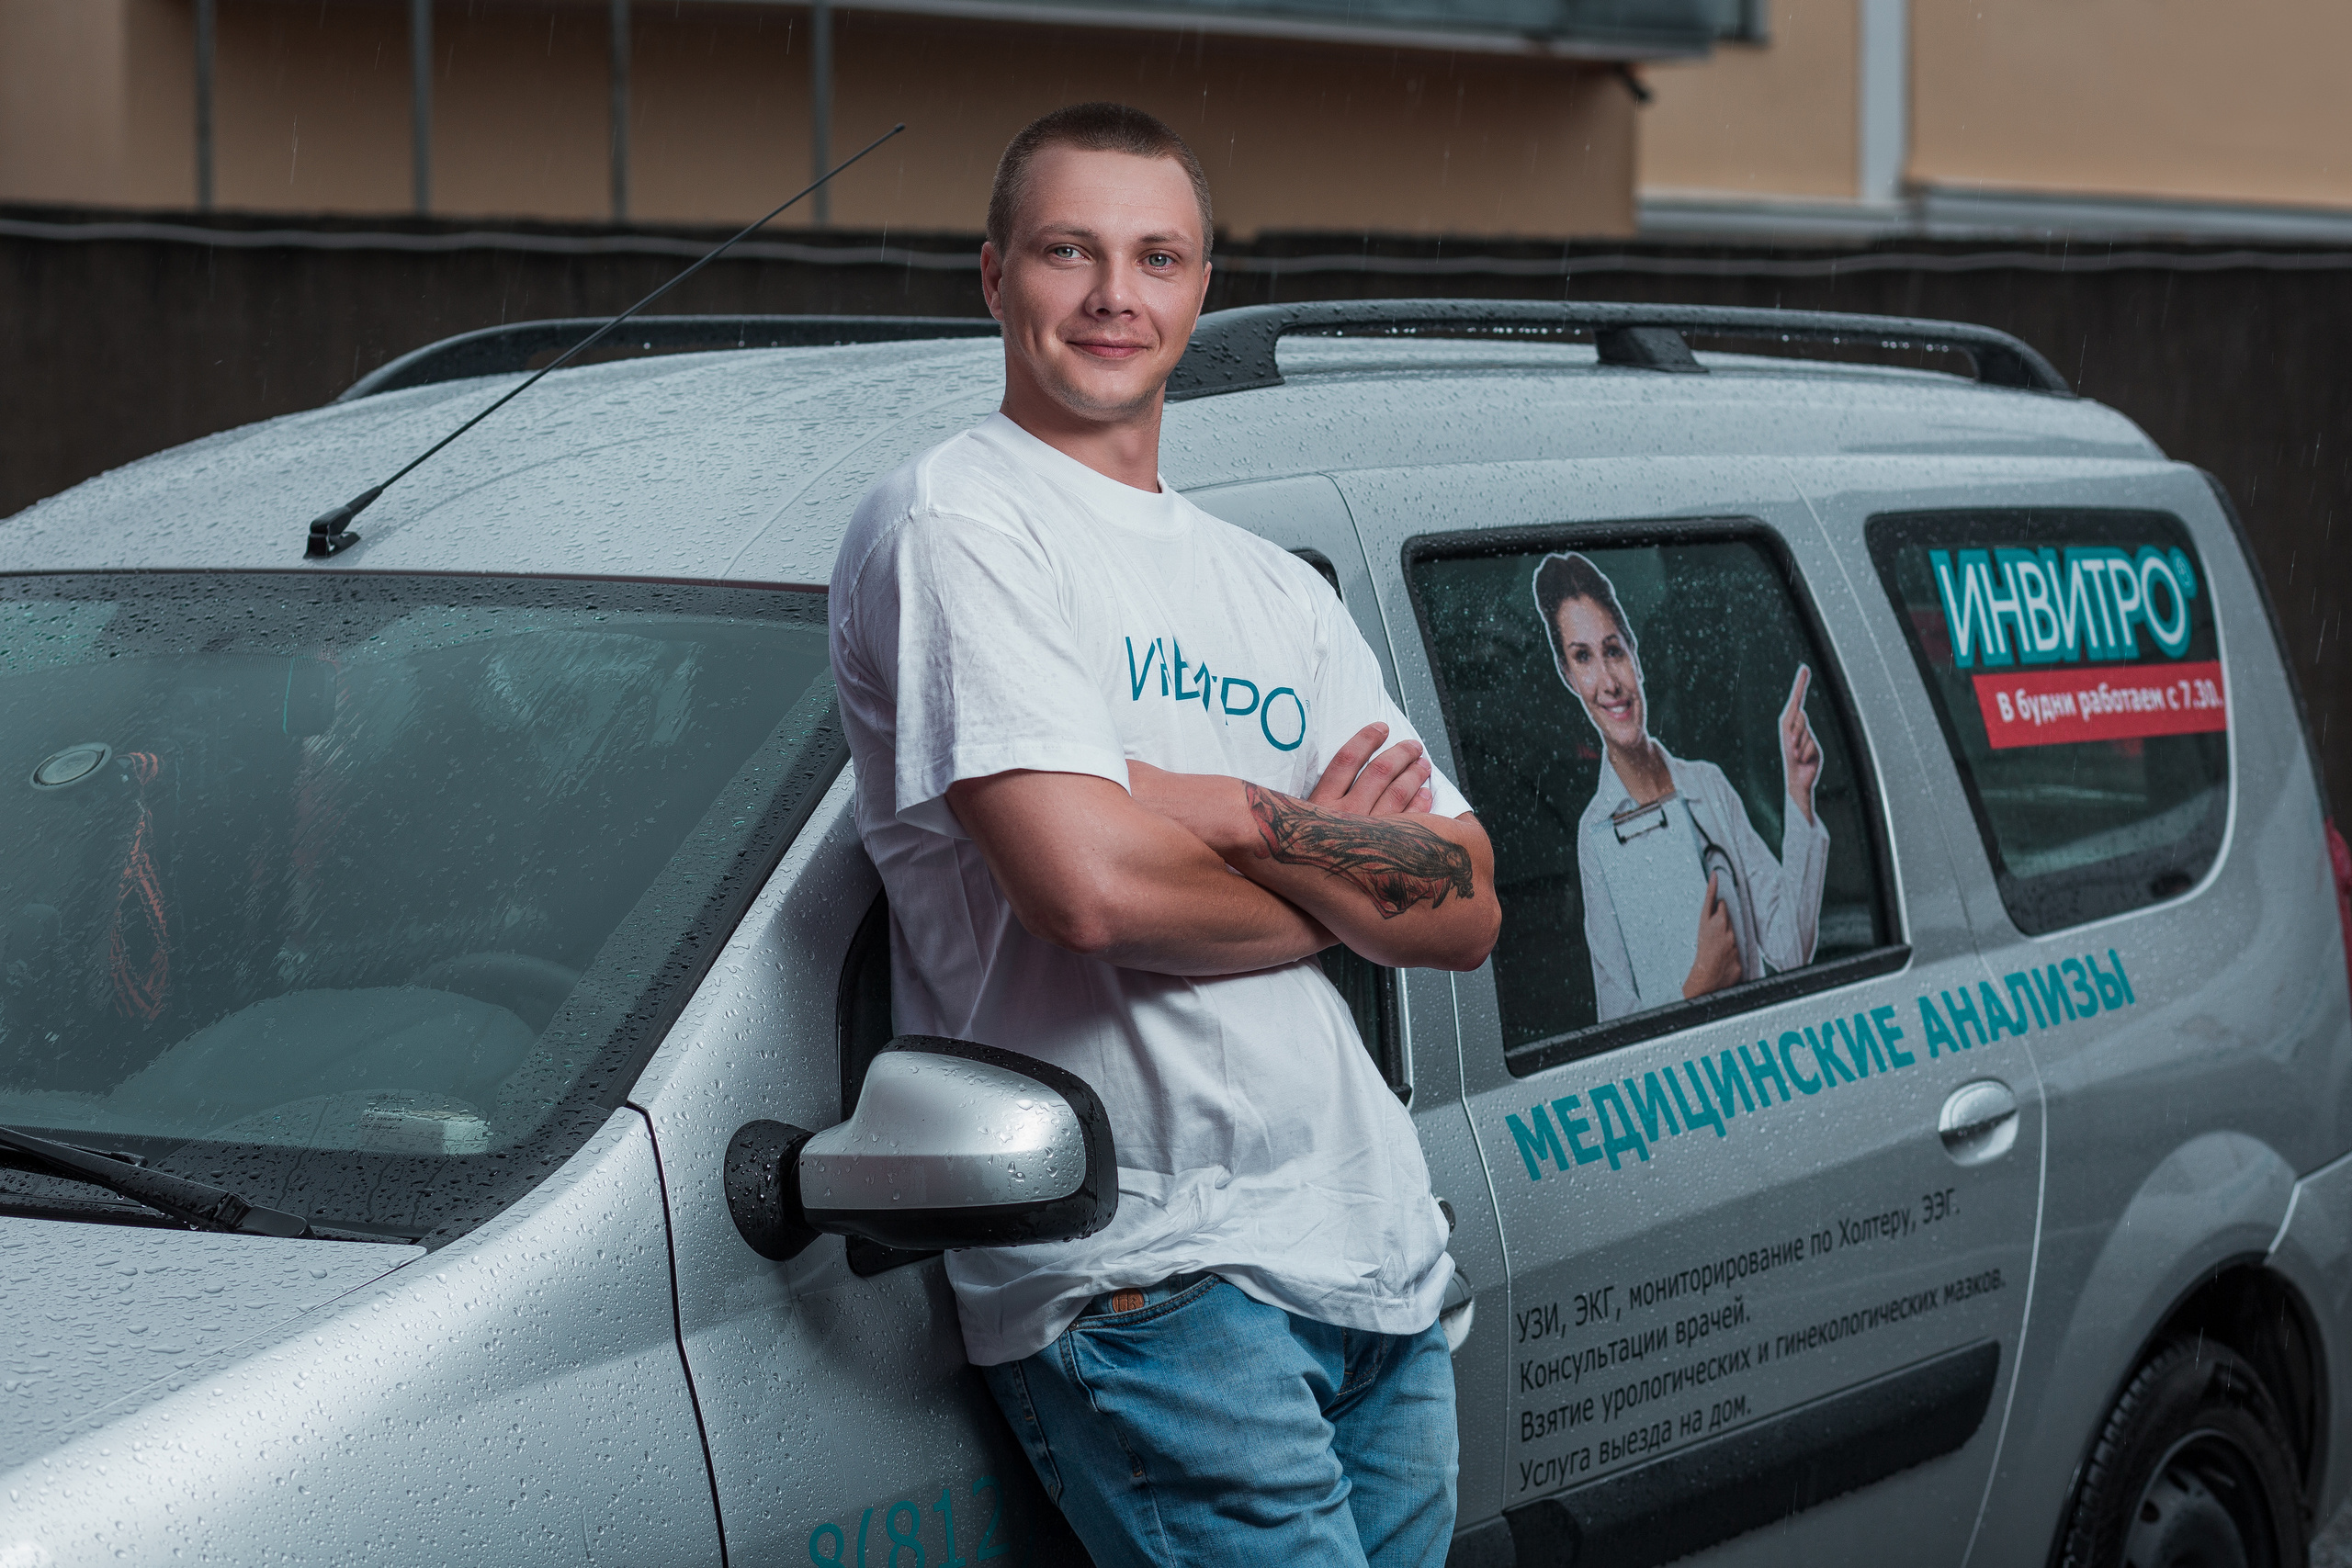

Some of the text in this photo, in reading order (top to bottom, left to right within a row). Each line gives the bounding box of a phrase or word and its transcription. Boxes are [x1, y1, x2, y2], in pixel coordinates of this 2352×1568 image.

[1939, 555, 2187, 657] ИНВИТРО
[1996, 692, 2016, 722] В
[2016, 689, 2076, 726] будни
[2077, 682, 2165, 722] работаем
[2166, 686, 2180, 710] с
[1505, 948, 2136, 1181] МЕДИЦИНСКИЕ АНАЛИЗЫ
[1517, 1188, 1962, 1343] УЗИ, ЭКГ, мониторирование по Холтеру, ЭЭГ.
[1520, 1295, 1751, 1393] Консультации врачей.
[1521, 1269, 2006, 1442] Взятие урологических и гинекологических мазков.
[1519, 1392, 1753, 1493] Услуга выезда на дом.
